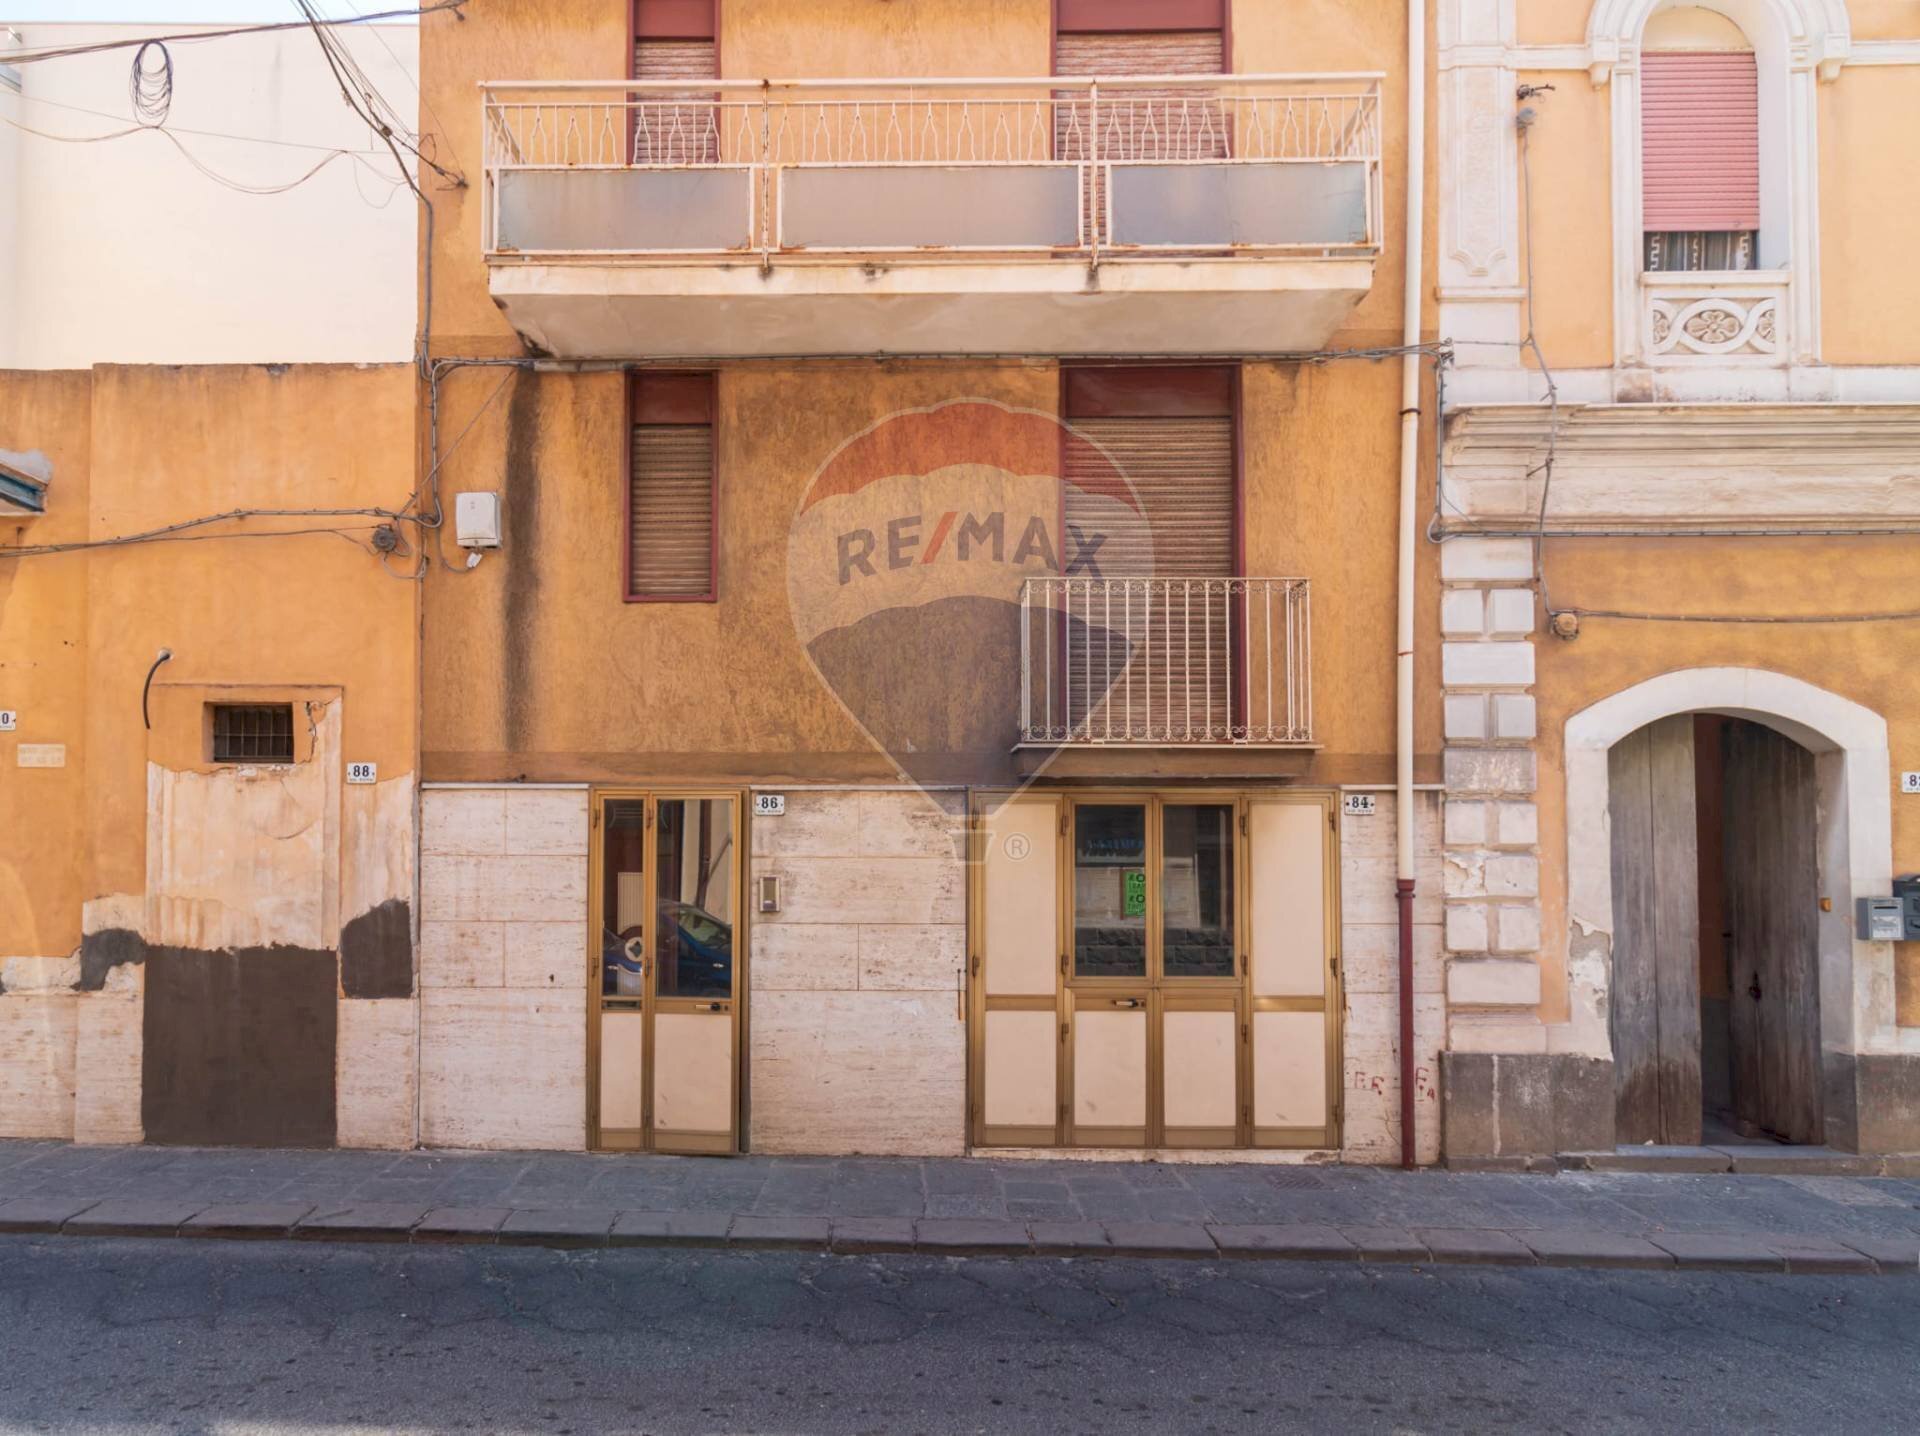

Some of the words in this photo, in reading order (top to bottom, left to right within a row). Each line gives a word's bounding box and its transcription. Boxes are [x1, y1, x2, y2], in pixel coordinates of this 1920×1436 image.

[353, 765, 370, 777] 88
[1909, 774, 1920, 787] 8
[761, 796, 778, 809] 86
[1352, 796, 1369, 809] 84
